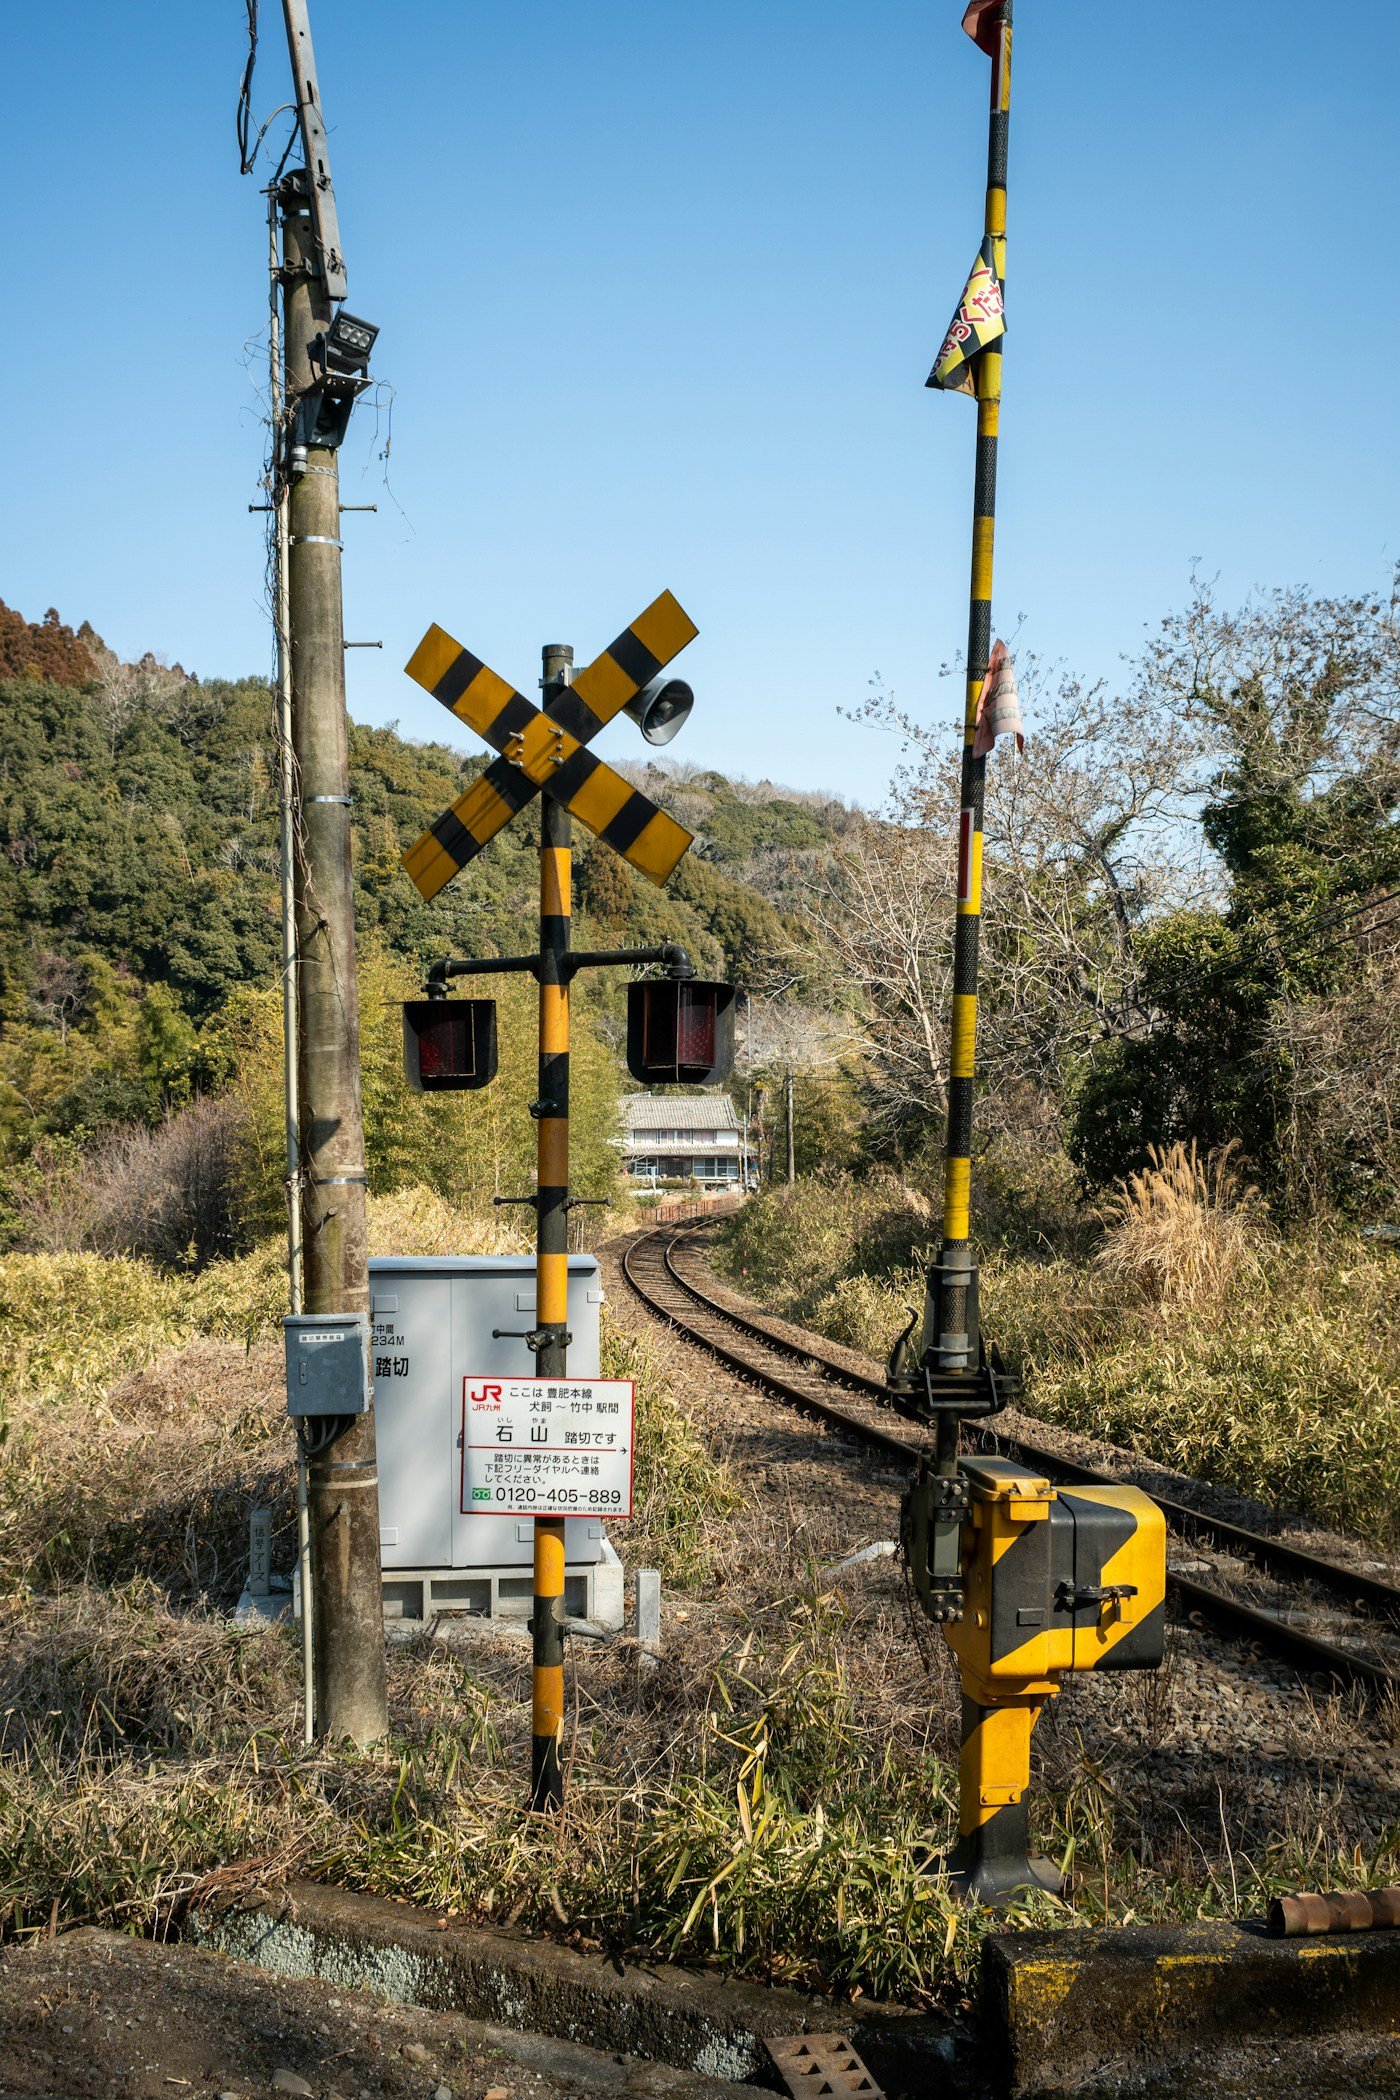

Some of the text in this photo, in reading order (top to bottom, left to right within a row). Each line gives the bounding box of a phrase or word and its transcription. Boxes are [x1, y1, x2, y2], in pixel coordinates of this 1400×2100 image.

[375, 1357, 409, 1377] 踏切
[471, 1385, 502, 1402] JR
[547, 1388, 593, 1399] 豊肥本線
[472, 1403, 501, 1411] JR九州
[529, 1402, 552, 1412] 犬飼
[571, 1402, 593, 1413] 竹中
[596, 1403, 619, 1414] 駅間
[496, 1425, 617, 1444] 石 山 踏切です
[494, 1453, 600, 1464] 踏切に異常があるときは
[484, 1464, 600, 1475] 下記フリーダイヤルへ連絡
[485, 1475, 546, 1484] してください。
[496, 1488, 621, 1504] 0120-405-889
[254, 1526, 265, 1581] 信号アース
